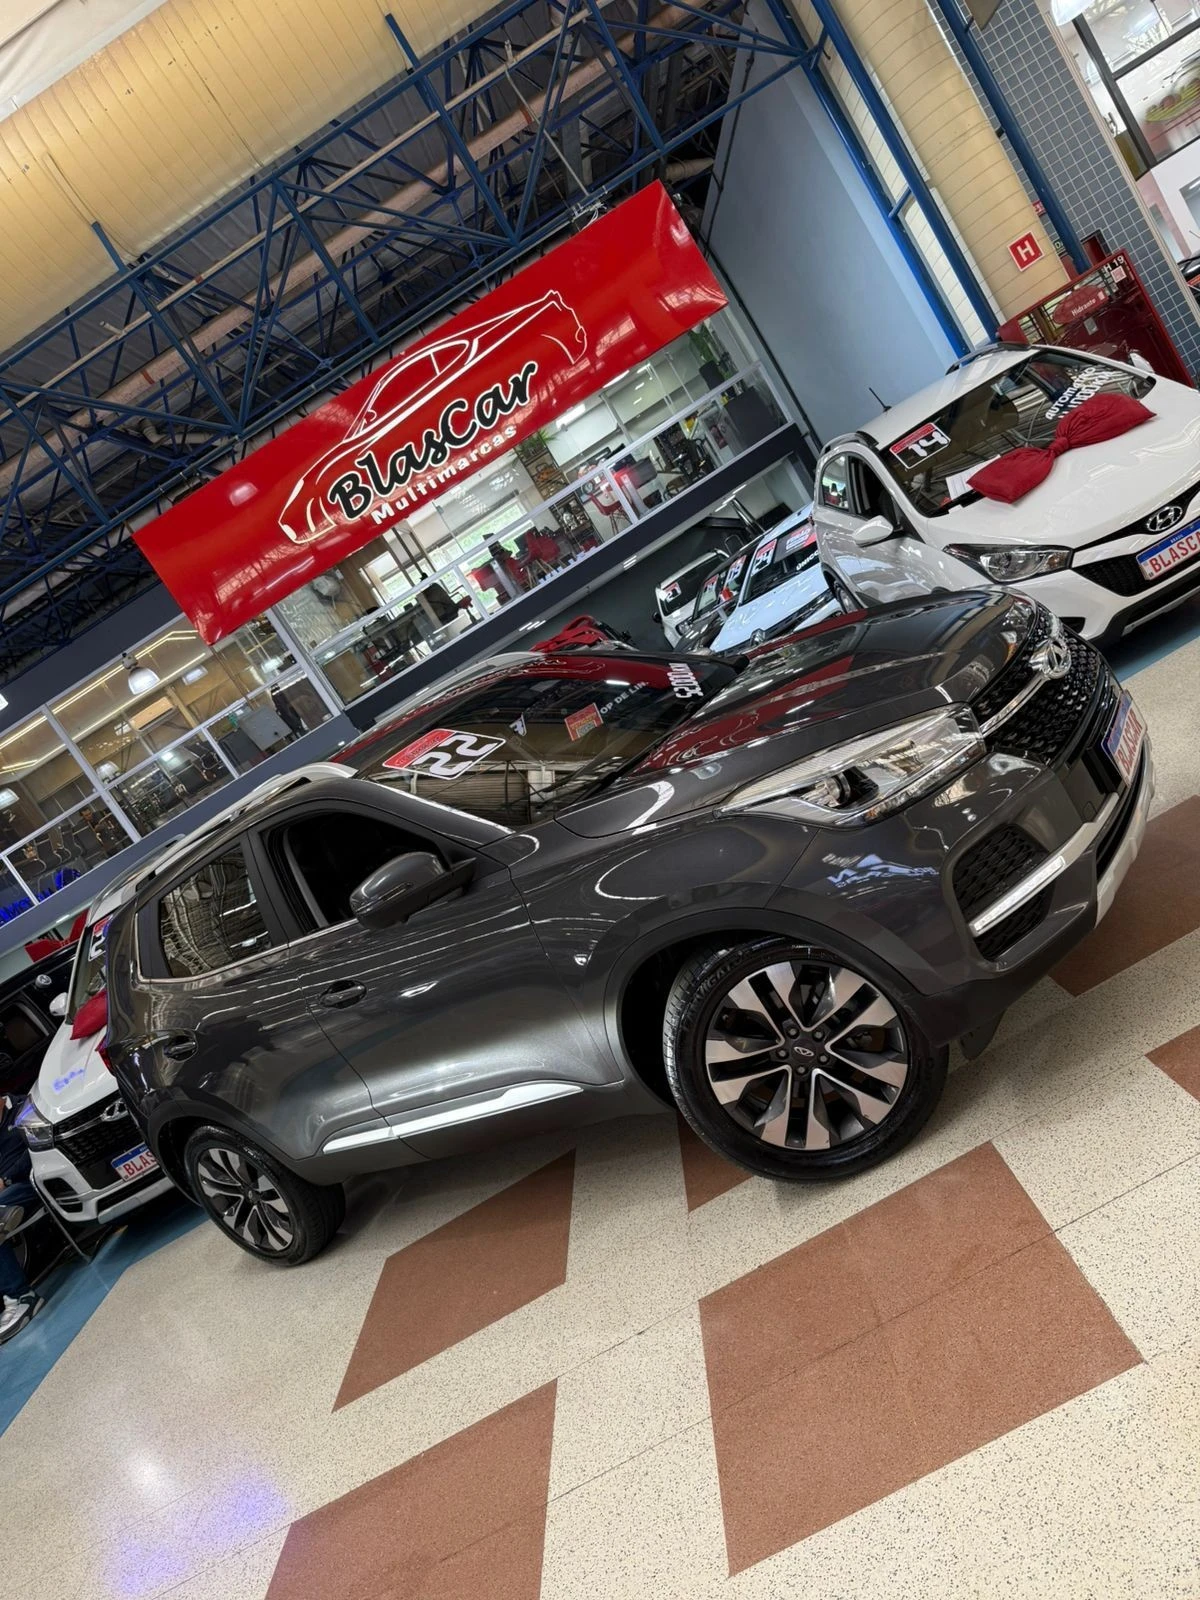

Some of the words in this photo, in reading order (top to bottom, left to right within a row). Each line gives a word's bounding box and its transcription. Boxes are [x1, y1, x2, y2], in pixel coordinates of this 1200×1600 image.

[1016, 240, 1035, 262] H
[1113, 255, 1124, 266] 19
[1071, 298, 1096, 317] Hidrante
[328, 360, 538, 520] BlasCar
[908, 430, 948, 457] 14
[371, 425, 517, 525] Multimarcas
[615, 690, 629, 704] DE
[412, 734, 498, 776] 22
[1116, 707, 1143, 776] BLASCAR
